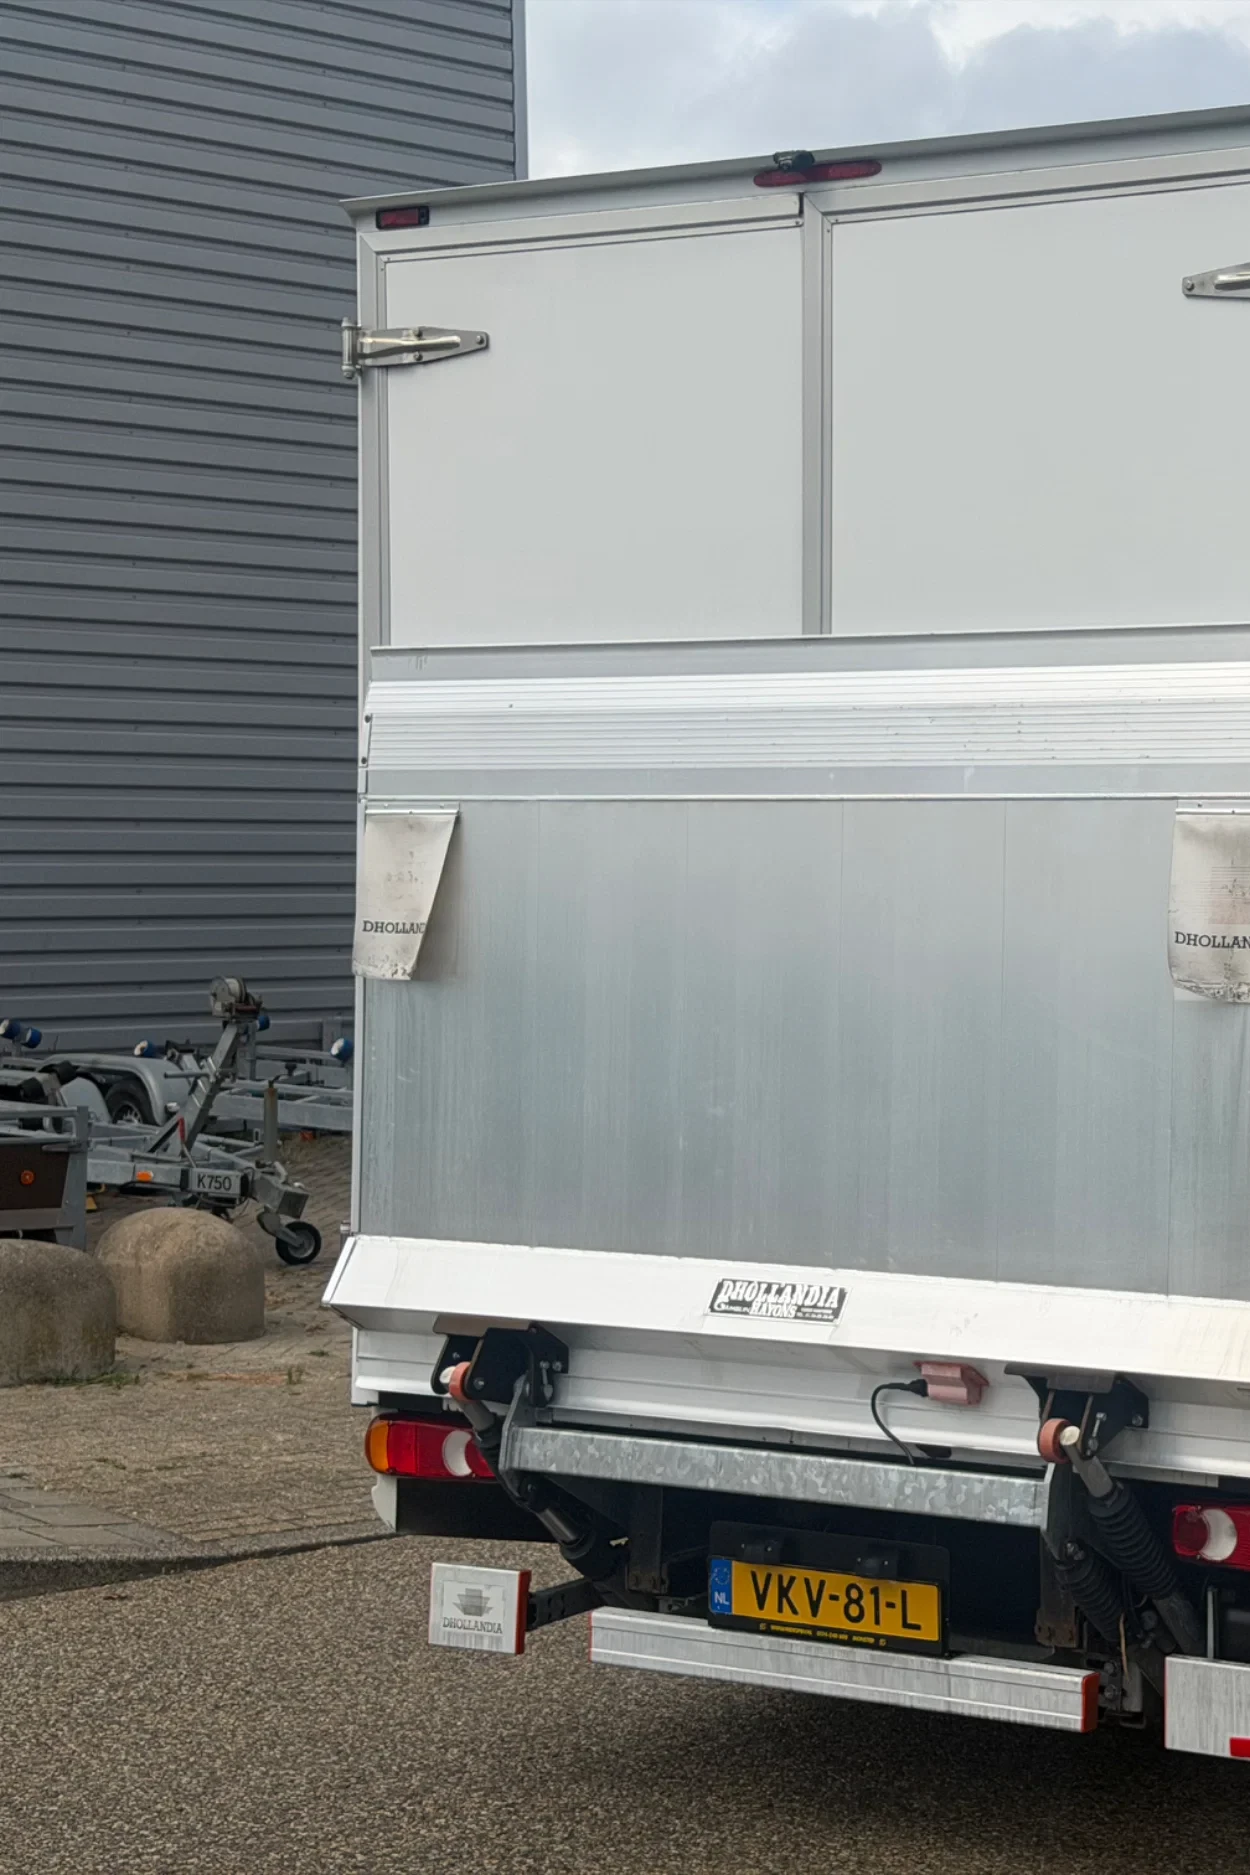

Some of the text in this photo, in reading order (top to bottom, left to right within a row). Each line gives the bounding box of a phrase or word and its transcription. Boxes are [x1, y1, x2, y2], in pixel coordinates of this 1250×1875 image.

[197, 1173, 232, 1191] K750
[718, 1279, 839, 1309] DHOLLANDIA
[748, 1299, 799, 1319] HAYONS
[714, 1591, 730, 1605] NL
[750, 1570, 922, 1631] VKV-81-L
[442, 1617, 503, 1634] DHOLLANDIA
